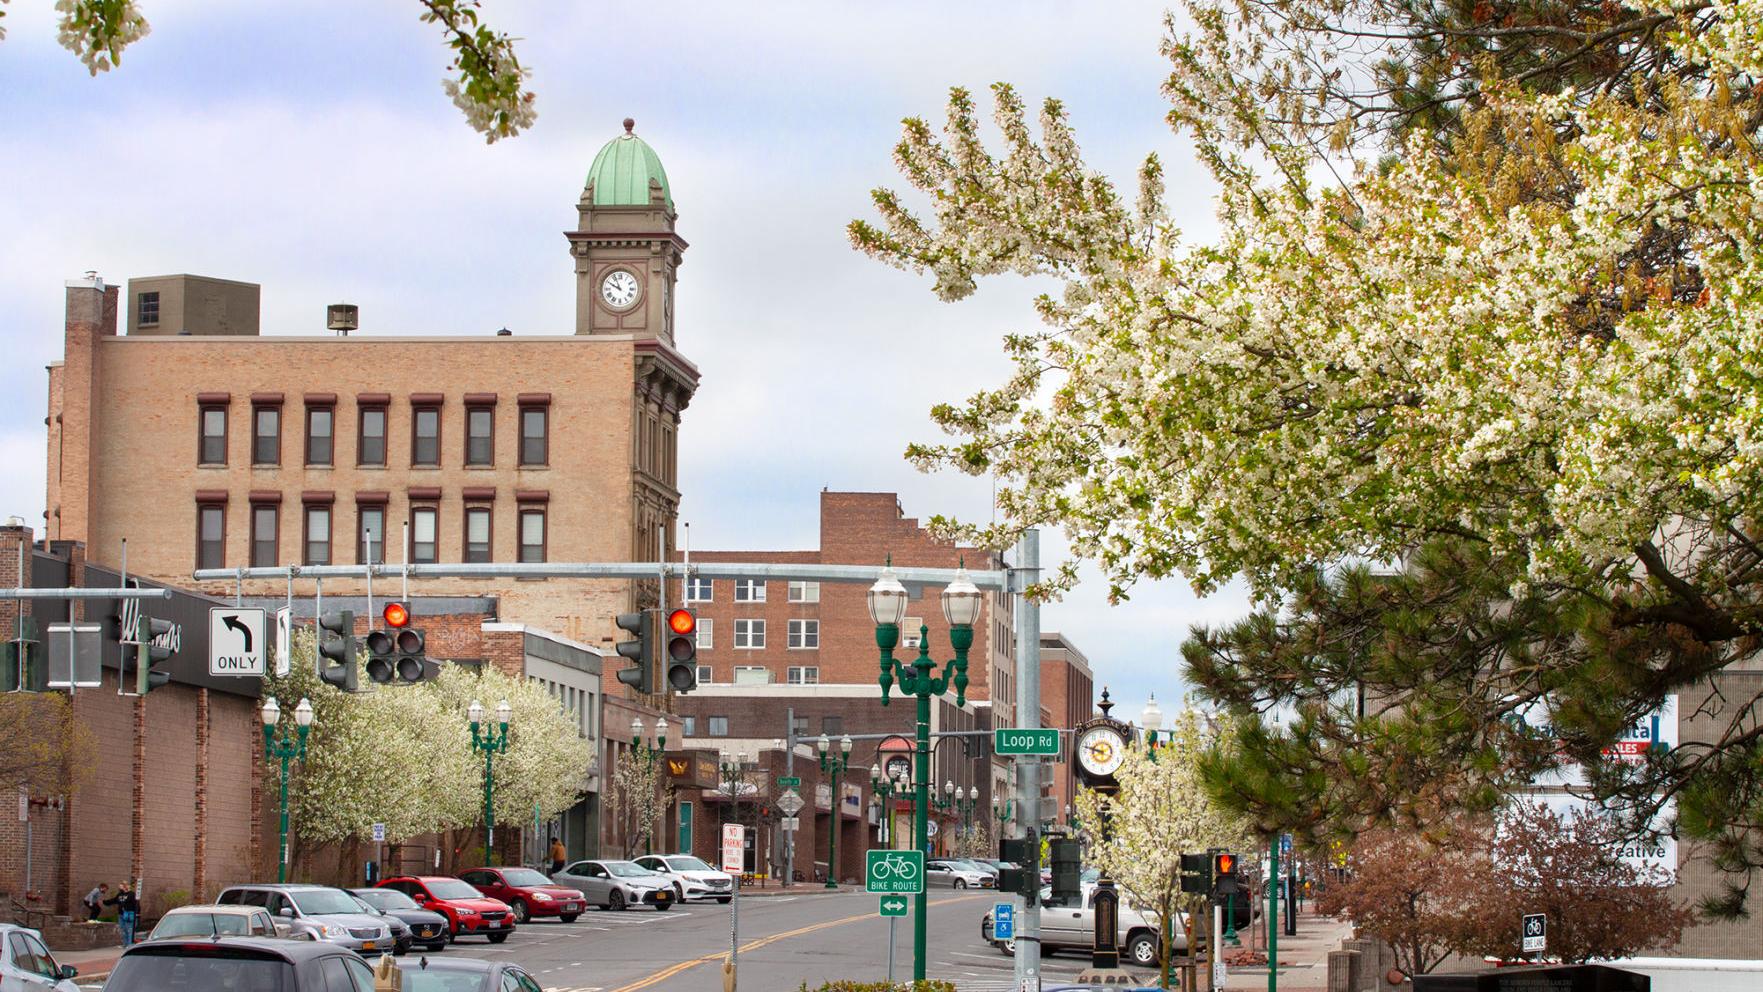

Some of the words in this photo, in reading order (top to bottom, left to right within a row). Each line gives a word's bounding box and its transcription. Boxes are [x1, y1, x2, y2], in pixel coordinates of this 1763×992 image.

[218, 656, 257, 669] ONLY
[1002, 731, 1035, 750] Loop
[1039, 735, 1052, 747] Rd
[729, 827, 738, 837] NO
[724, 838, 743, 848] PARKING
[871, 881, 888, 890] BIKE
[892, 881, 917, 890] ROUTE
[1525, 940, 1533, 948] BIKE
[1534, 938, 1544, 947] LANE
